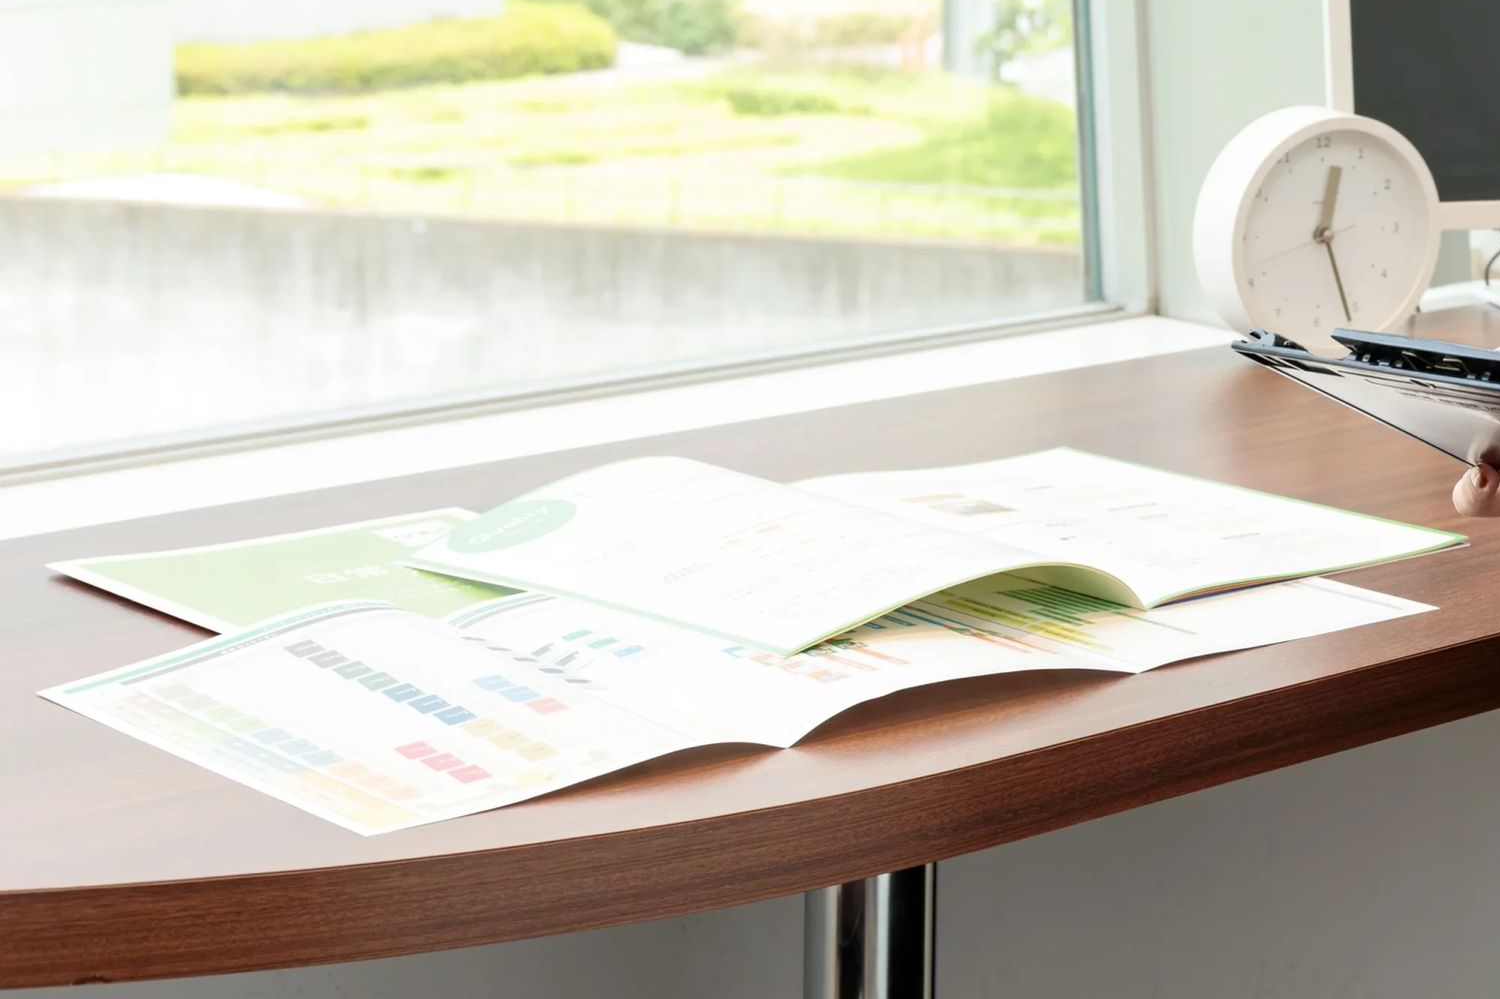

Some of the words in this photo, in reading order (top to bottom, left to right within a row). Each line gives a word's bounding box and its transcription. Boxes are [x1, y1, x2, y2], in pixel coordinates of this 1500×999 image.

[1315, 137, 1332, 149] 12
[1358, 148, 1364, 159] 1
[1384, 178, 1391, 190] 2
[1393, 222, 1399, 233] 3
[1380, 269, 1387, 279] 4
[1353, 302, 1359, 312] 5
[1275, 308, 1281, 319] 7
[1313, 317, 1320, 328] 6
